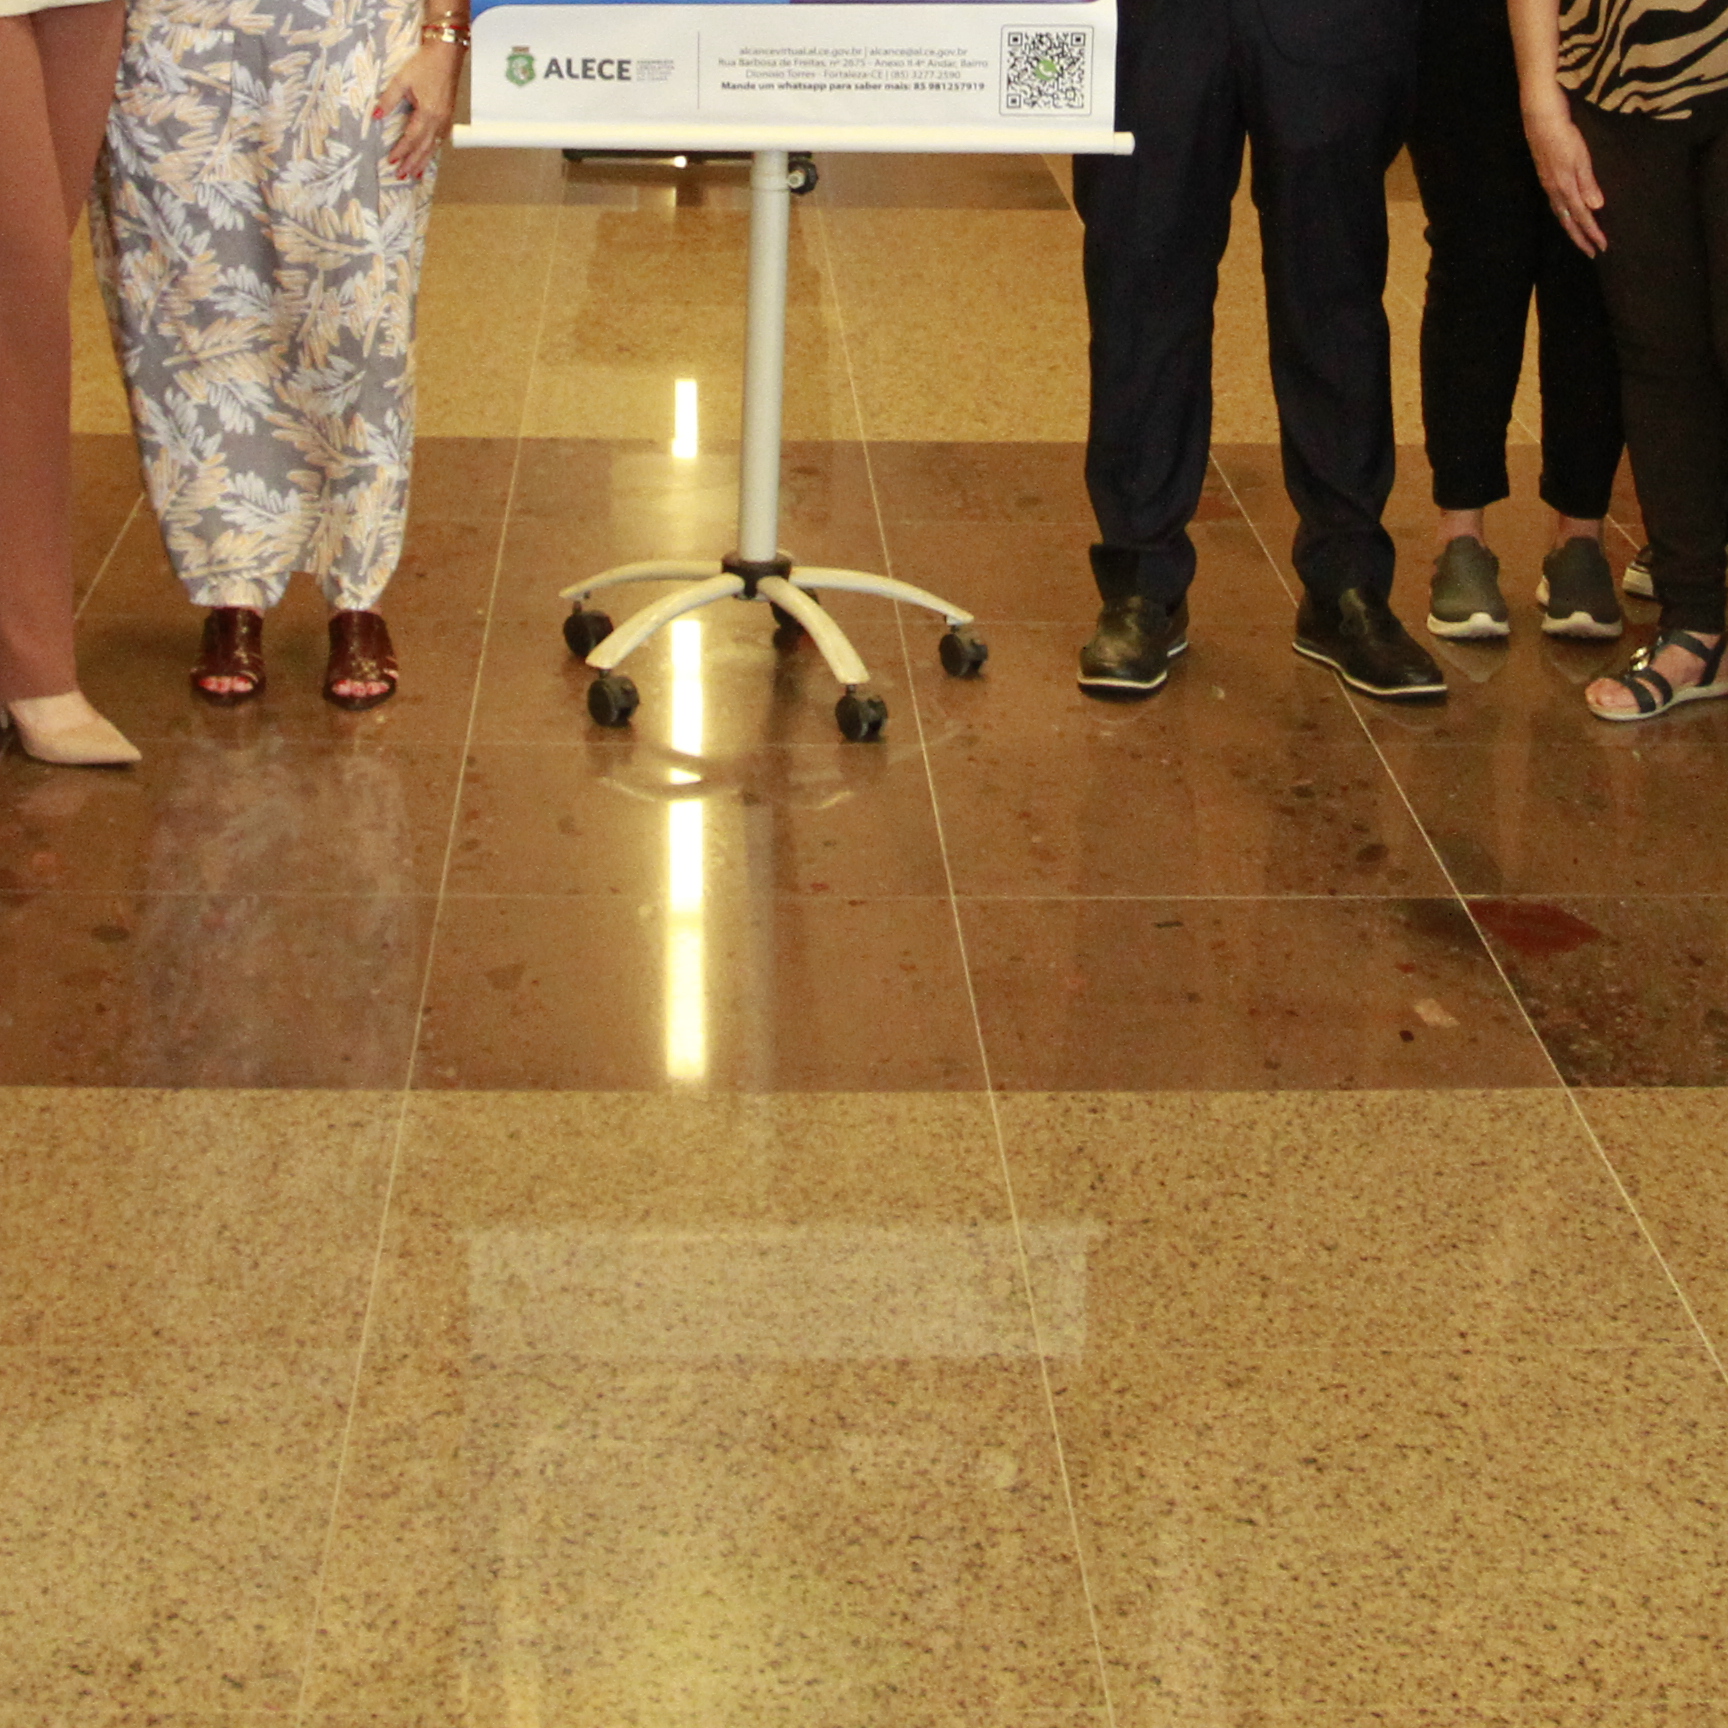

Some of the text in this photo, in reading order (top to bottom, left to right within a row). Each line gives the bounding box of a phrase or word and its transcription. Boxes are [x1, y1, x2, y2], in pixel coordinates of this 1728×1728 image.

[544, 58, 631, 81] ALECE
[722, 82, 756, 90] Mande
[777, 82, 827, 92] whatsapp
[829, 84, 852, 92] para
[855, 82, 882, 90] saber
[885, 82, 911, 90] mais:
[913, 82, 926, 90] 85
